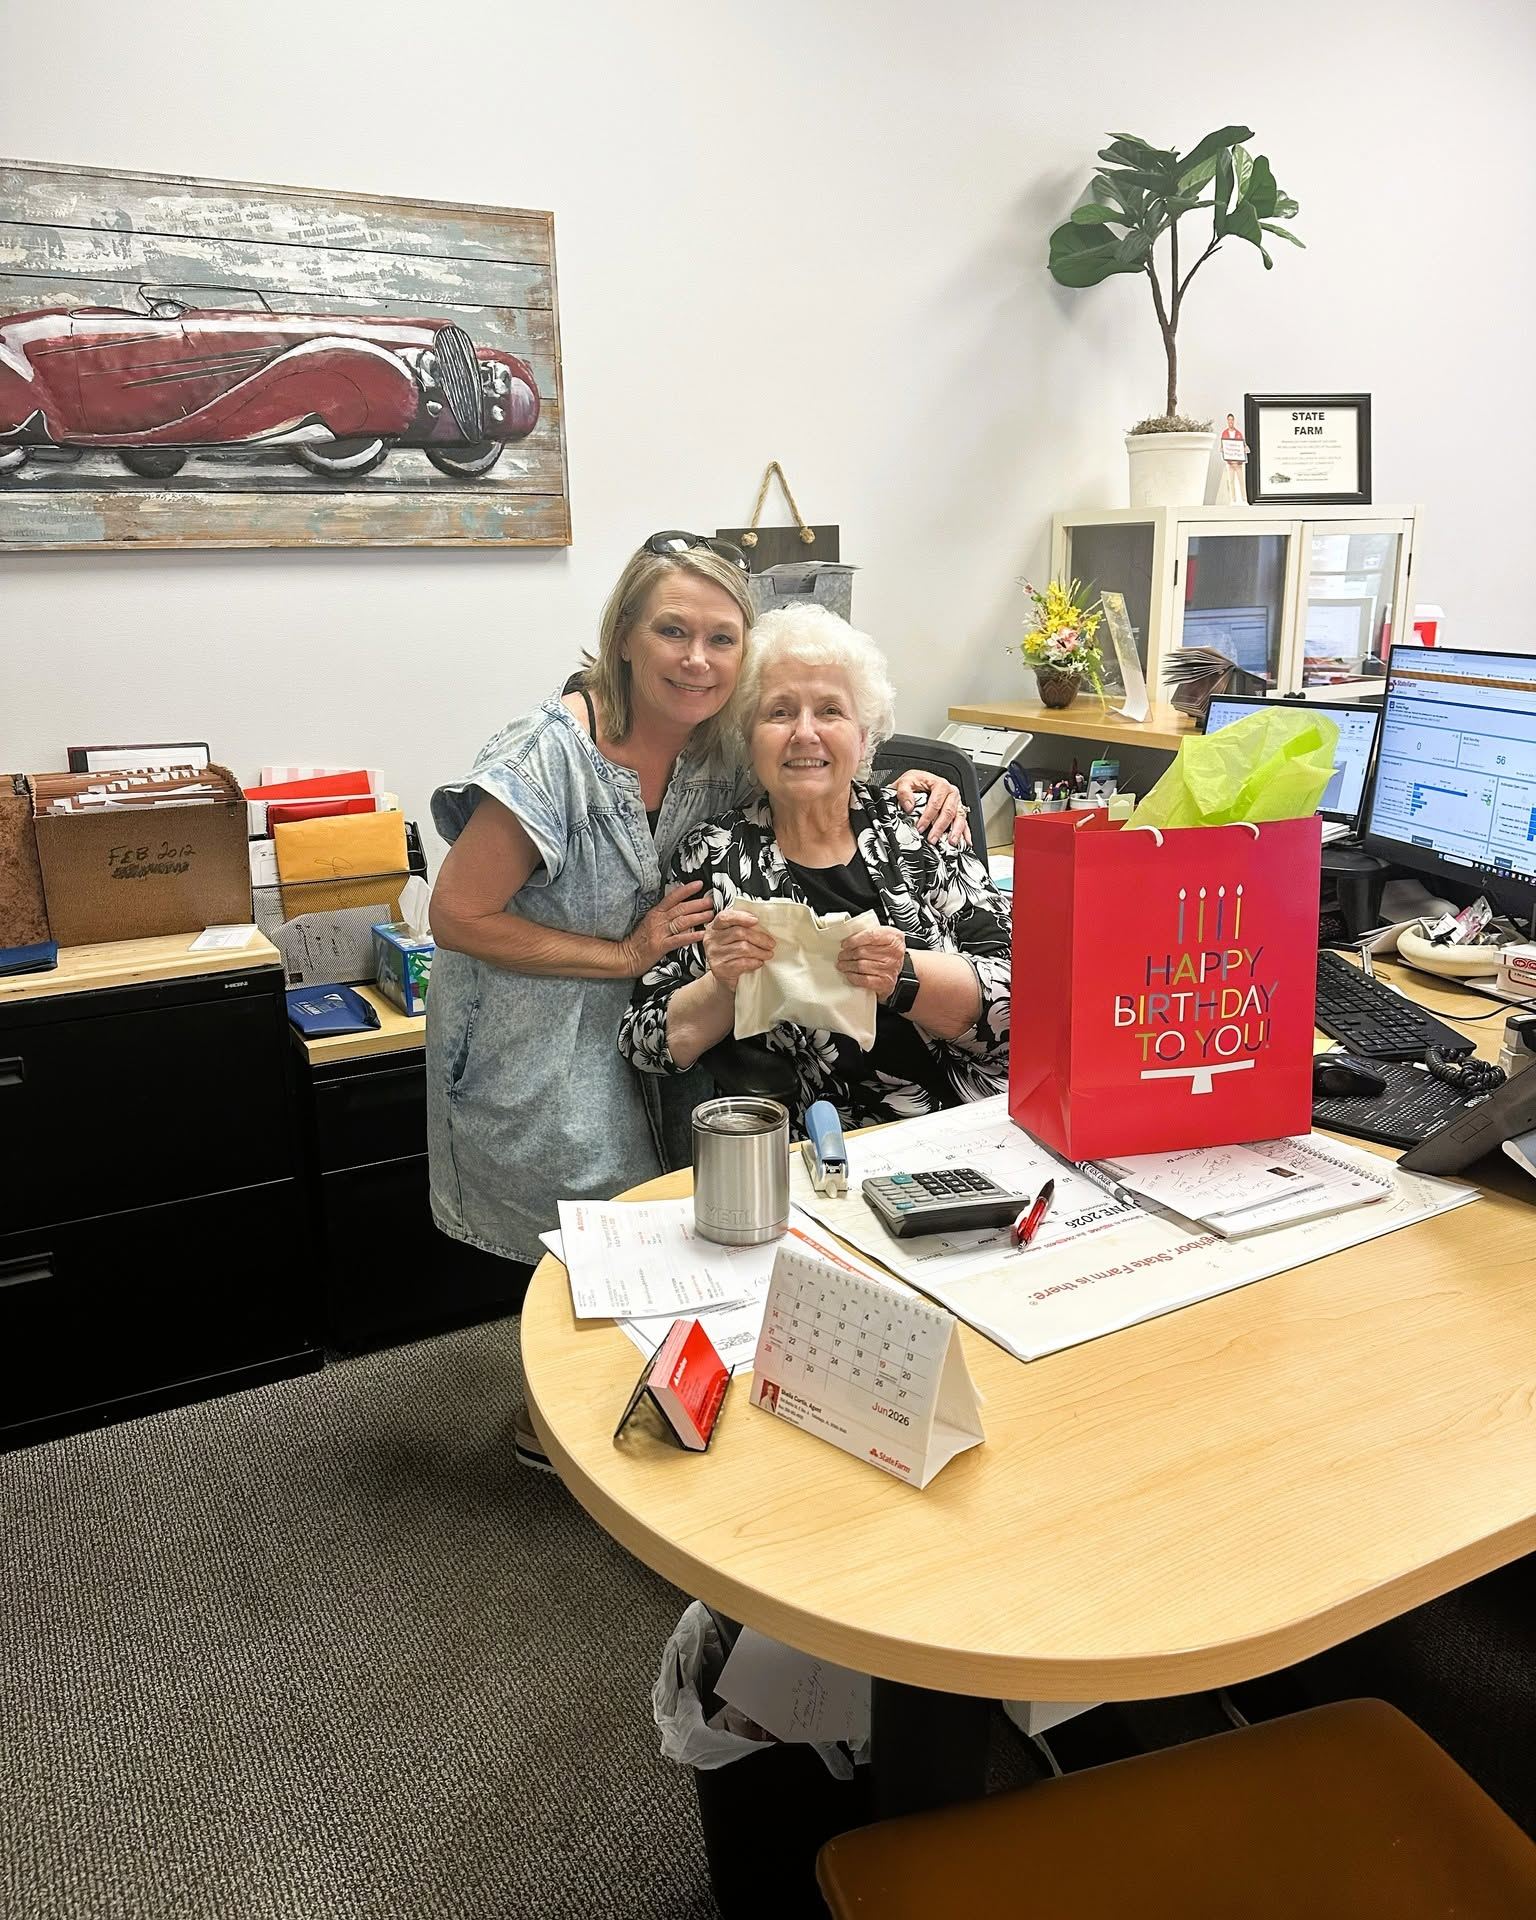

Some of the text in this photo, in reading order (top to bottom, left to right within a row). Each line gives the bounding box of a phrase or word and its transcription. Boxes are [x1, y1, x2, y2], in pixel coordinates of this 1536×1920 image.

[303, 227, 326, 240] main
[1292, 412, 1325, 421] STATE
[1294, 426, 1323, 435] FARM
[1416, 741, 1422, 751] 0
[1495, 755, 1506, 765] 56
[108, 841, 196, 866] FEB 2012
[1146, 946, 1264, 986] HAPPY
[1114, 980, 1278, 1027] BIRTHDAY
[1135, 1018, 1271, 1061] TO YOU!
[704, 1201, 753, 1225] YETI
[1098, 1199, 1142, 1217] JUNE
[1064, 1212, 1102, 1229] 2026
[1131, 1253, 1173, 1268] State
[1075, 1275, 1091, 1287] is
[1089, 1264, 1134, 1283] Farm
[820, 1294, 825, 1302] 2
[864, 1313, 869, 1321] 4
[887, 1323, 892, 1331] 5
[911, 1333, 916, 1342] 6
[795, 1302, 800, 1310] 8
[838, 1321, 846, 1330] 10
[860, 1332, 866, 1340] 11
[883, 1342, 890, 1351] 12
[906, 1352, 914, 1361] 13
[792, 1320, 799, 1328] 15
[813, 1329, 820, 1338] 16
[834, 1339, 842, 1347] 17
[857, 1349, 863, 1358] 18
[880, 1360, 887, 1368] 19
[902, 1370, 911, 1380] 20
[785, 1353, 793, 1362] 29
[806, 1364, 814, 1373] 30
[788, 1336, 796, 1345] 22
[809, 1346, 817, 1355] 23
[830, 1357, 839, 1365] 24
[852, 1367, 861, 1376] 25
[875, 1378, 884, 1388] 26
[898, 1389, 907, 1398] 27
[878, 1451, 911, 1474] State Farm
